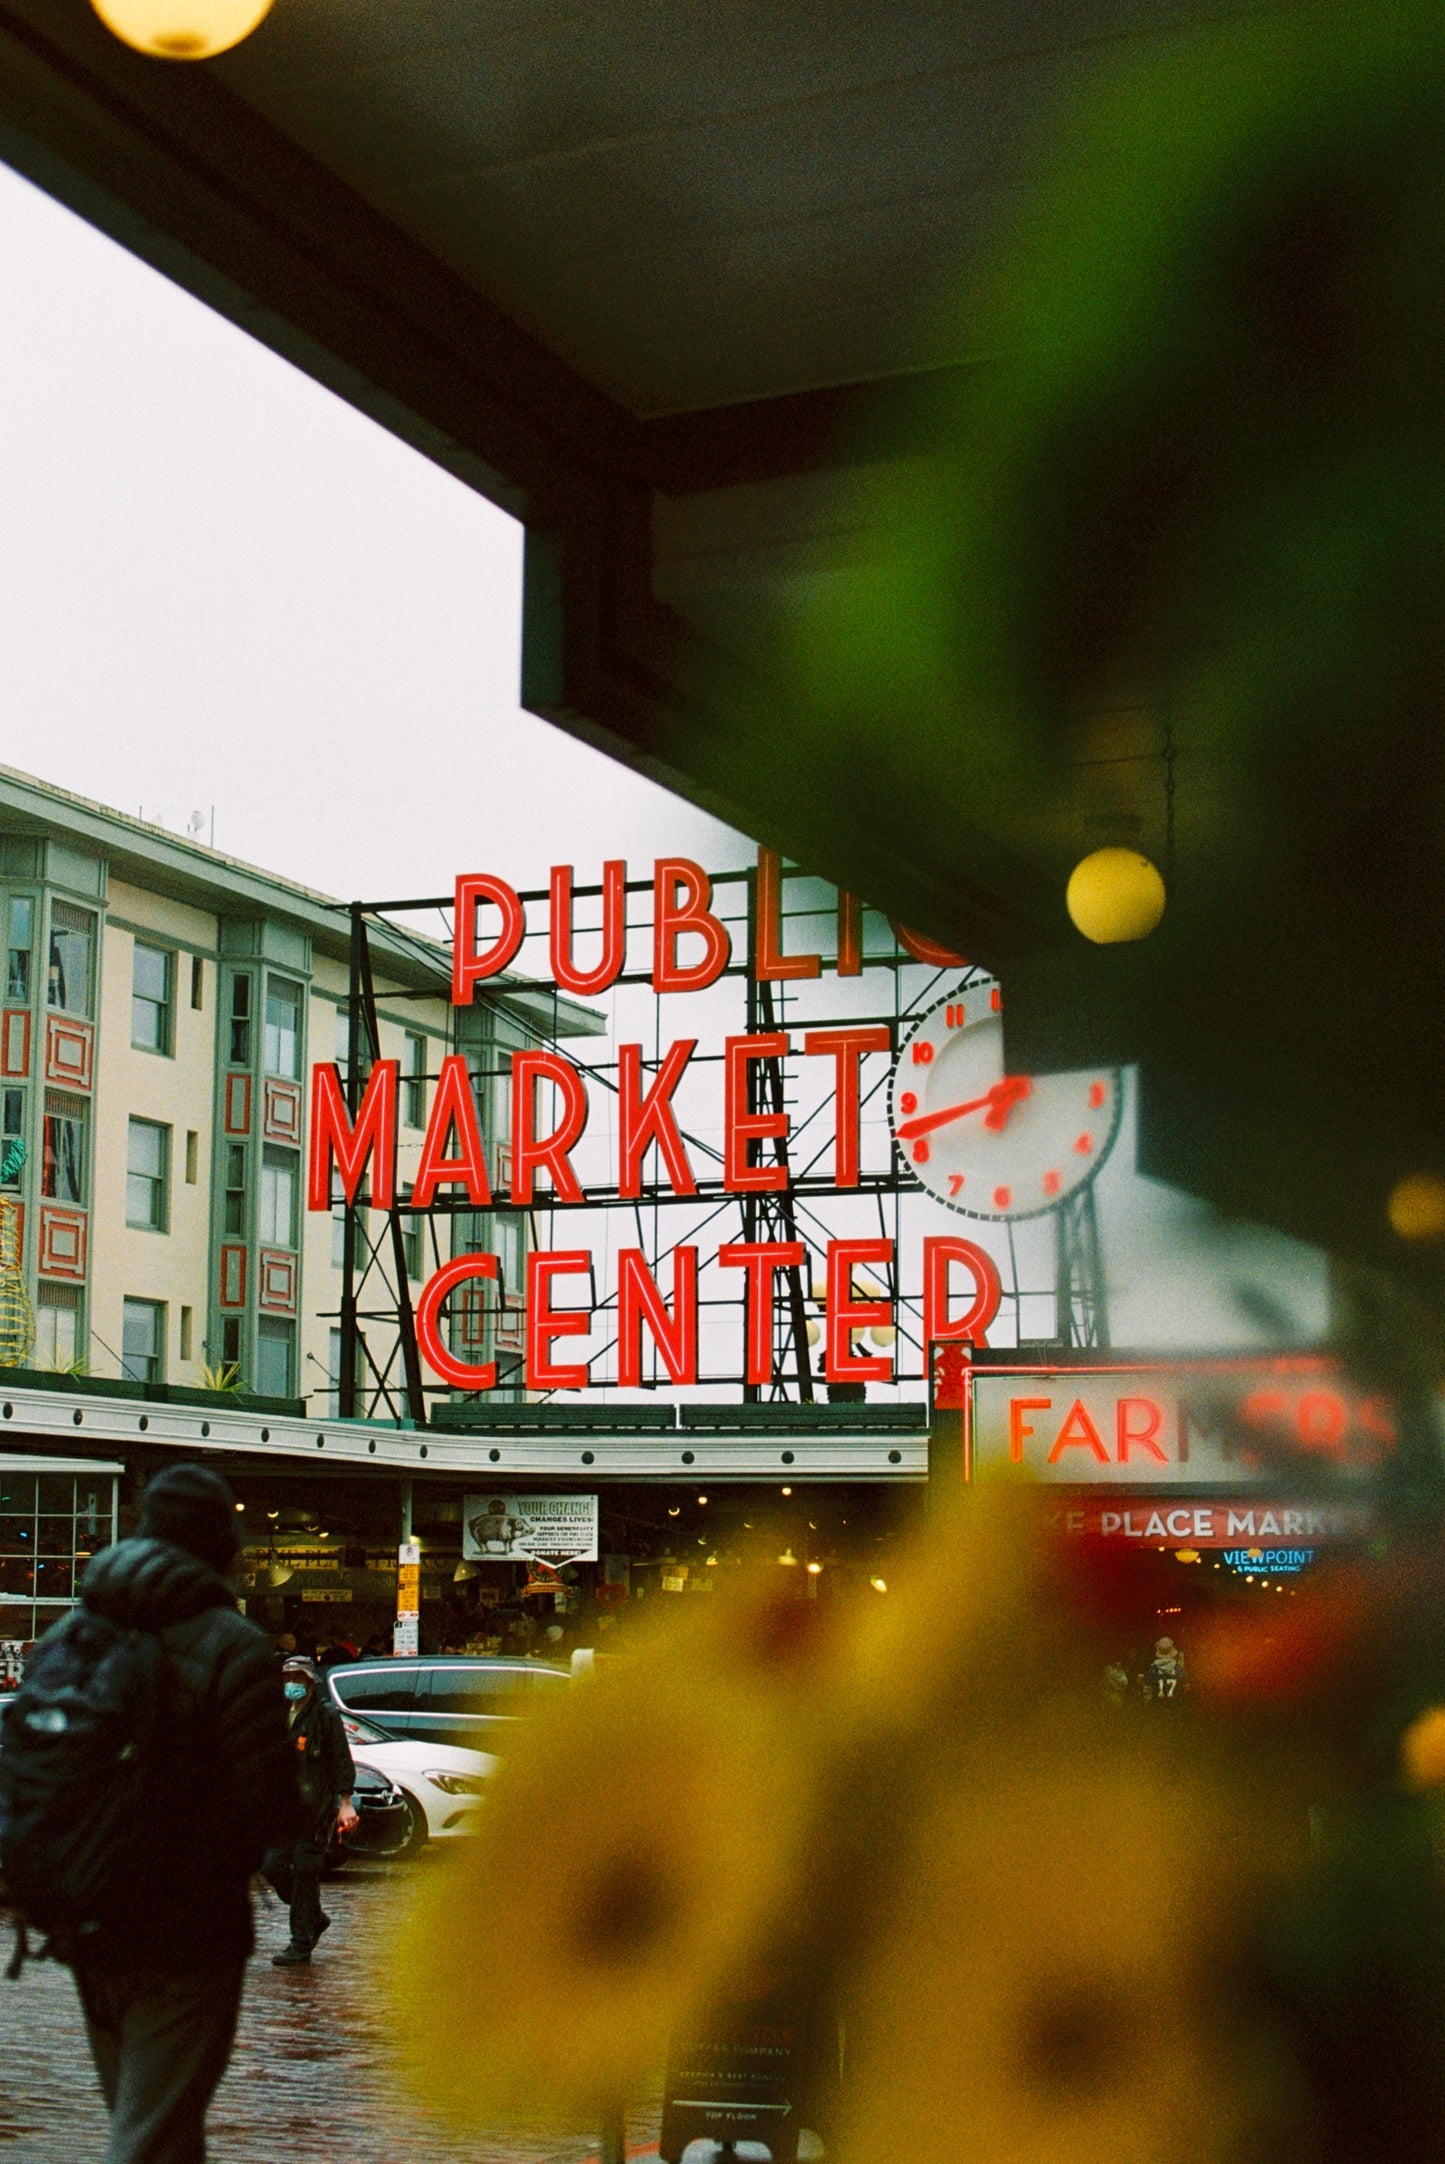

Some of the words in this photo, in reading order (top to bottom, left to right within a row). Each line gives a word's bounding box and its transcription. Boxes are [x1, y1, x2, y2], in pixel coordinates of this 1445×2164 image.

[912, 1041, 934, 1065] 10
[901, 1091, 918, 1114] 9
[308, 1027, 891, 1211] MARKET
[912, 1139, 930, 1163] 8
[948, 1174, 965, 1197] 7
[417, 1236, 1002, 1390] CENTER
[518, 1501, 547, 1515] YOUR
[1101, 1509, 1213, 1536] PLACE
[1223, 1550, 1315, 1564] VIEWPOINT
[1244, 1565, 1268, 1573] PUBLIC
[1158, 1679, 1177, 1698] 17
